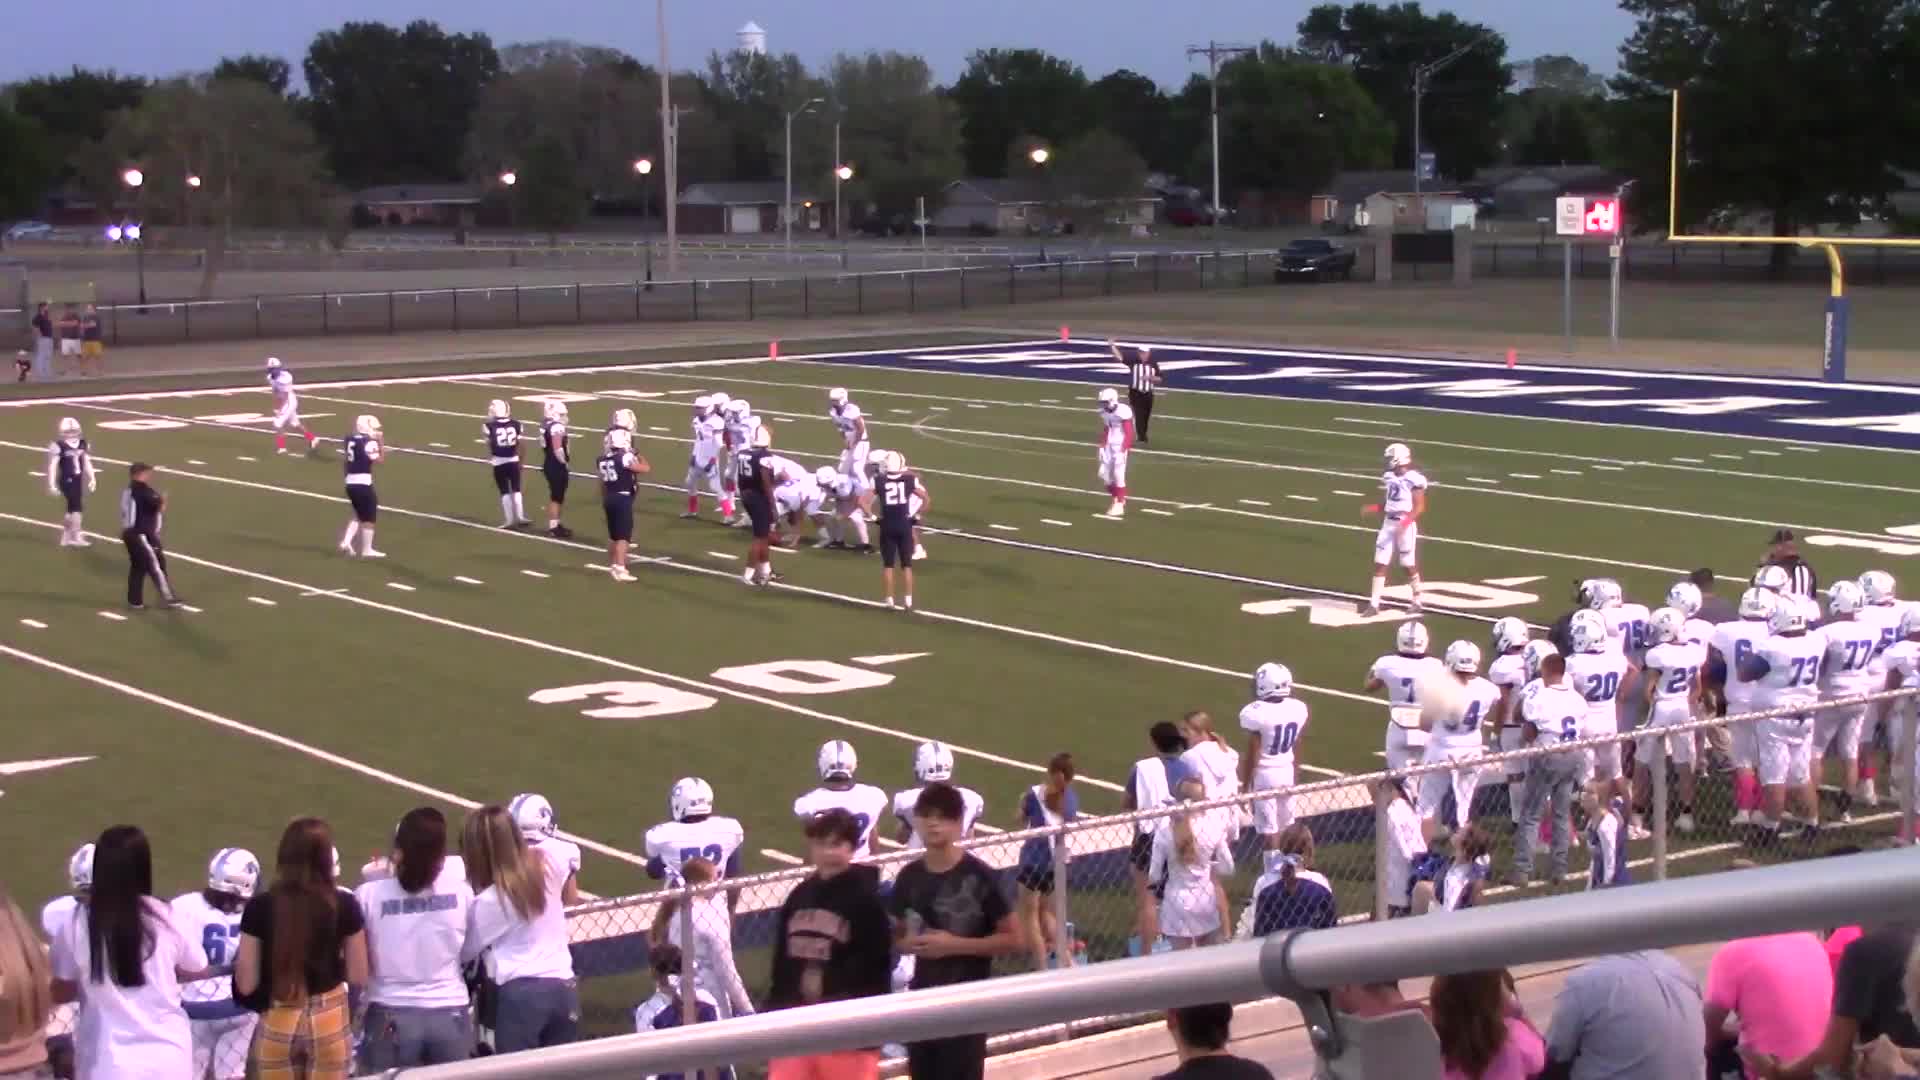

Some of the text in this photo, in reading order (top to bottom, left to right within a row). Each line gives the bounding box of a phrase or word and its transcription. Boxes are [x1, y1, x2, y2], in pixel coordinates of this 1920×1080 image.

[496, 427, 517, 446] 22
[885, 482, 907, 505] 21
[1839, 639, 1872, 671] 77
[1584, 671, 1618, 702] 20
[1788, 655, 1819, 688] 73
[528, 660, 896, 719] 30
[1268, 721, 1298, 756] 10
